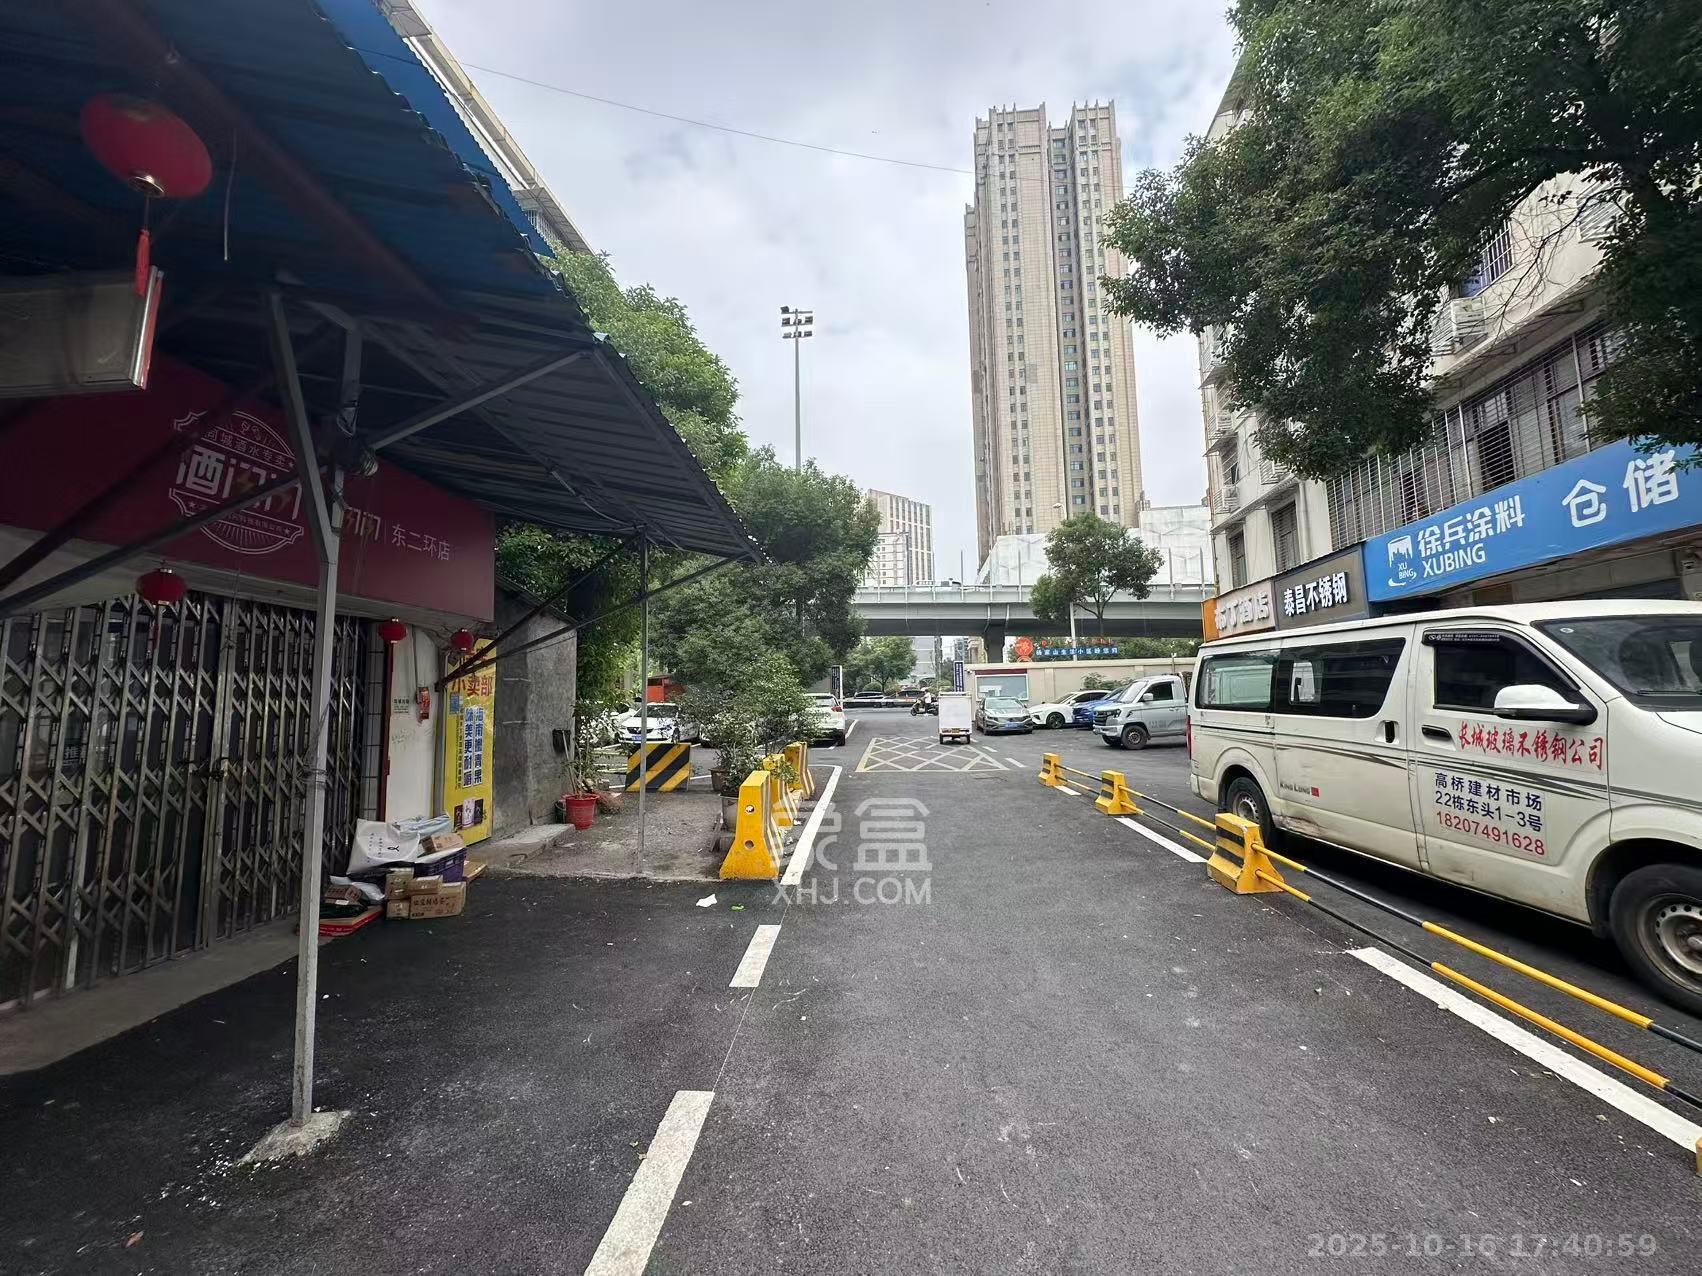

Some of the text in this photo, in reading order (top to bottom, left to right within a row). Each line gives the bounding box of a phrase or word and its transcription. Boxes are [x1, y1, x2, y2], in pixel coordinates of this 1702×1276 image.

[1417, 450, 1679, 558] 徐兵涂料 仓储
[391, 523, 451, 561] 东二环店
[1422, 543, 1486, 578] XUBING
[1398, 561, 1408, 570] XU
[1398, 568, 1414, 580] BING
[1283, 571, 1349, 617] 泰昌不锈钢
[1458, 720, 1604, 771] 长城玻璃不锈钢公司
[1434, 772, 1543, 812] 高桥建材市场
[1435, 790, 1543, 832] 22栋东头1-3号
[1436, 811, 1545, 856] 18207491628
